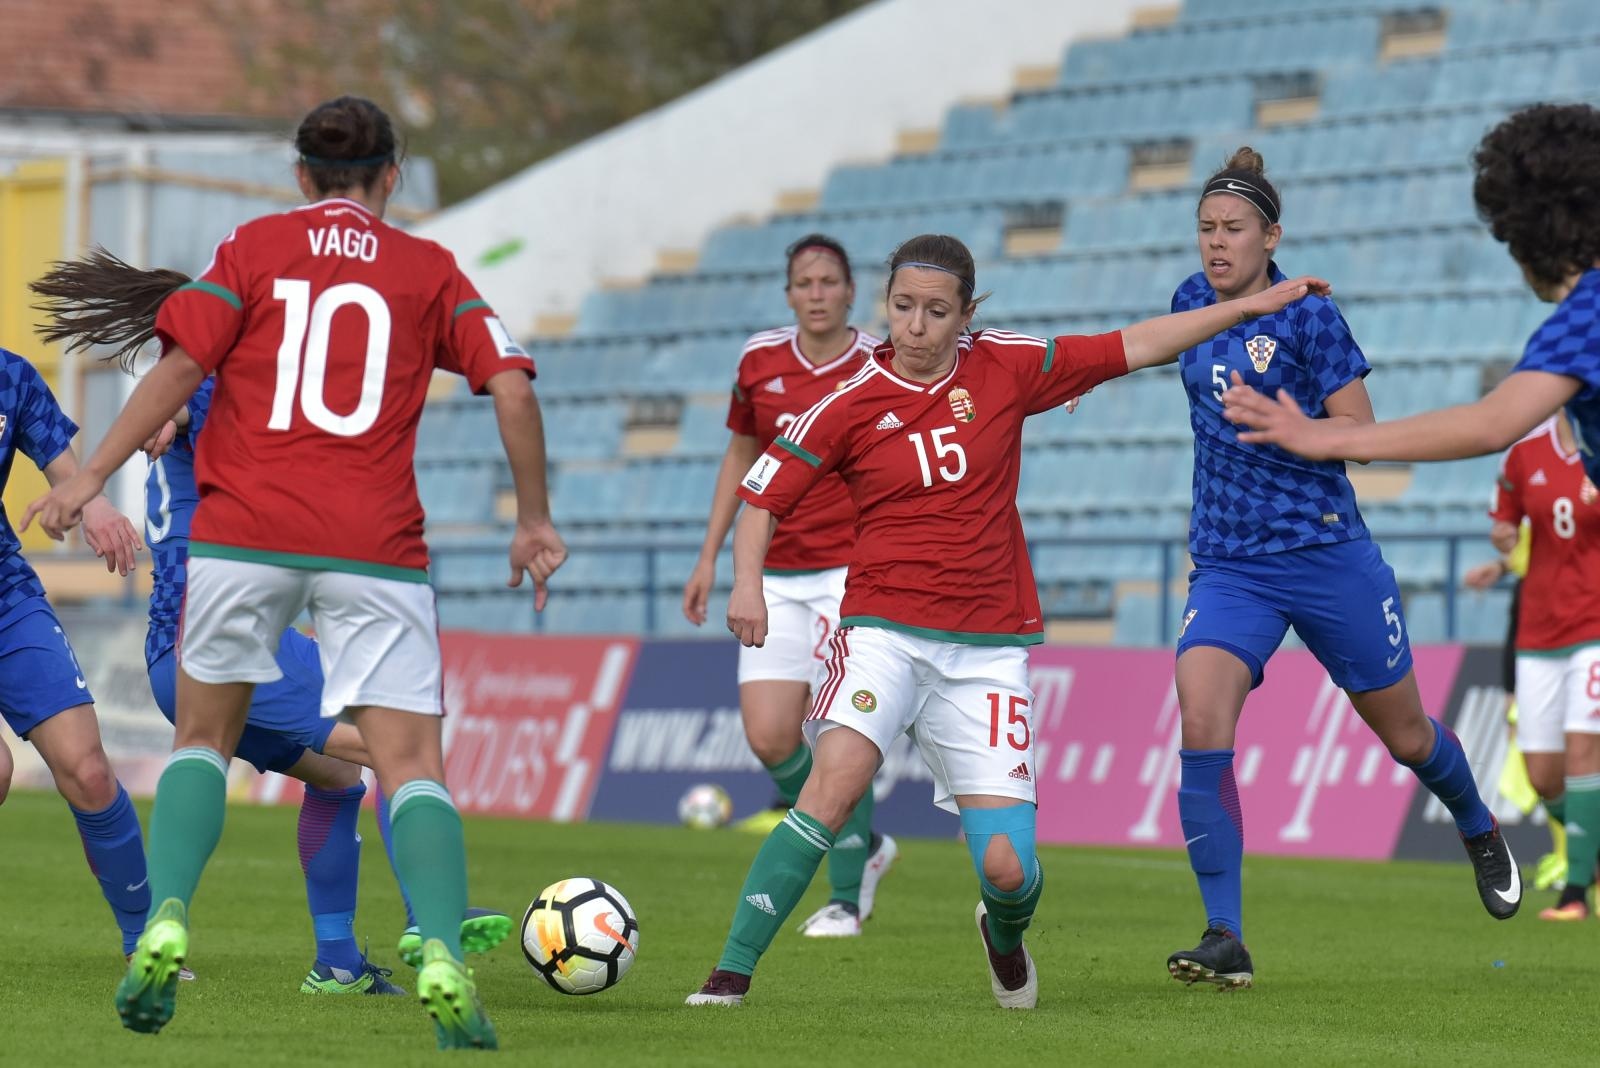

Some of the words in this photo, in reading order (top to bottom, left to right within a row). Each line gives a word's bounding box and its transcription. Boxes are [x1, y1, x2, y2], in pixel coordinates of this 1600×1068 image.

[307, 223, 378, 263] VÁGÓ
[267, 278, 391, 437] 10
[1212, 364, 1228, 402] 5
[908, 426, 967, 488] 15
[1552, 497, 1576, 539] 8
[1382, 596, 1402, 647] 5
[986, 692, 1030, 752] 15
[1008, 771, 1032, 783] adidas
[745, 895, 777, 916] adidas
